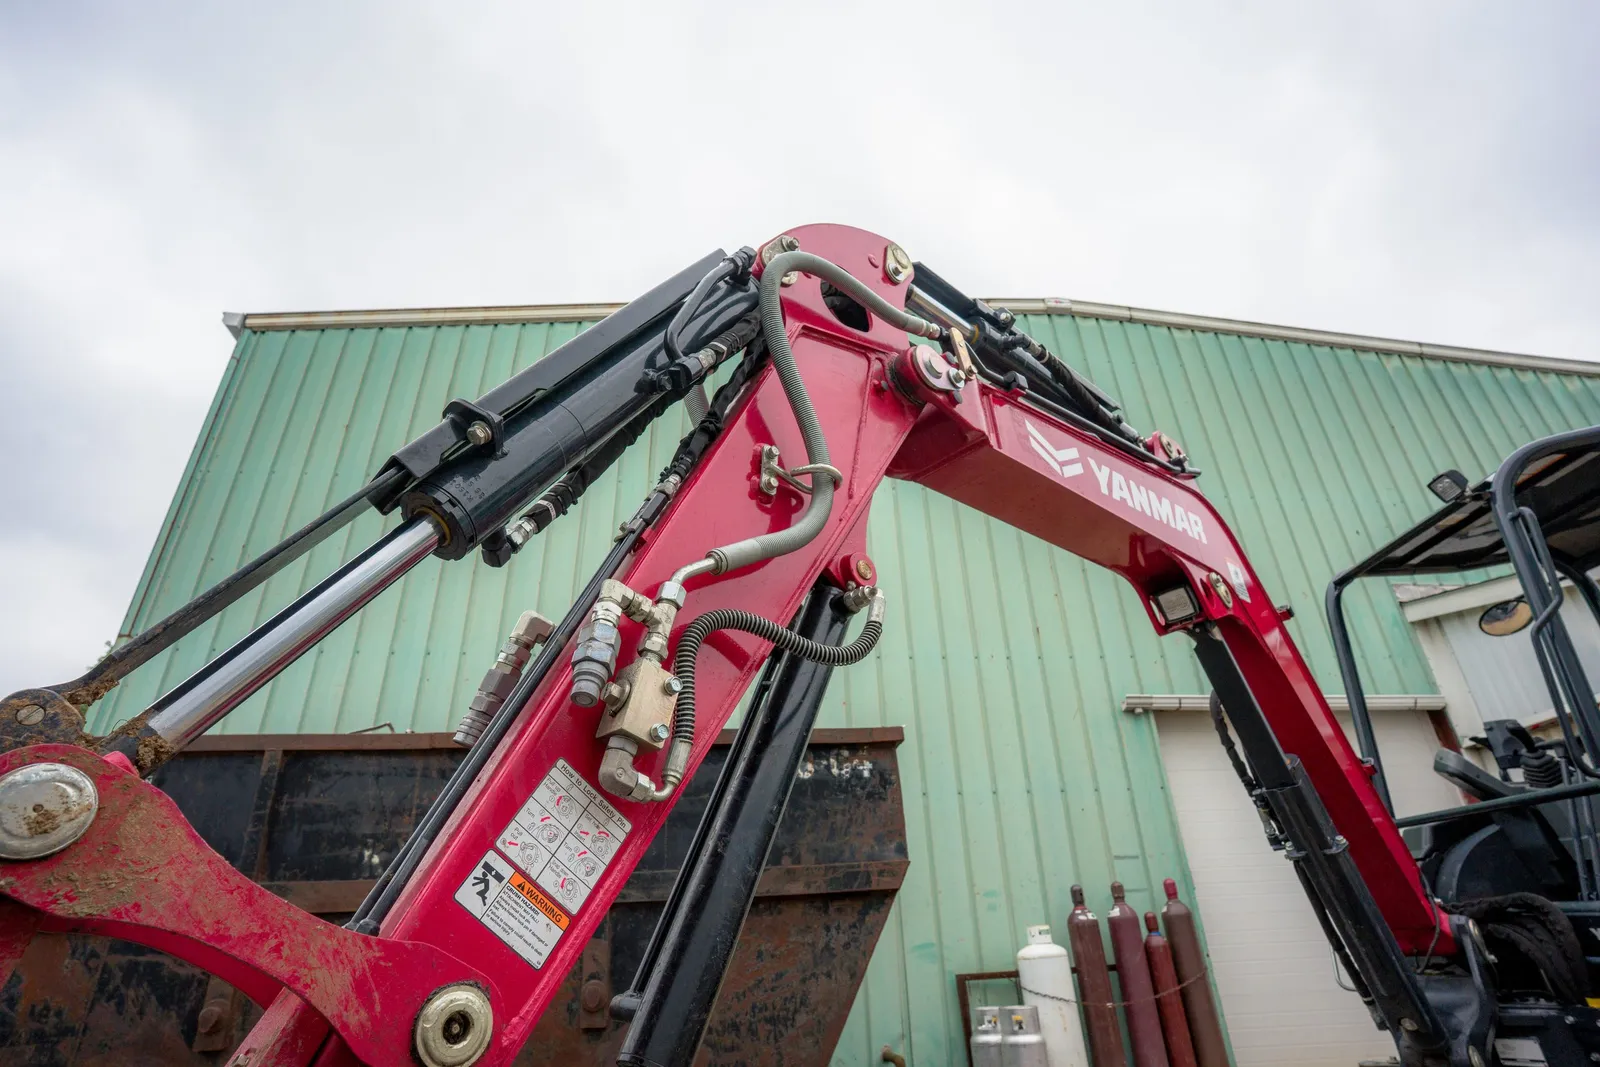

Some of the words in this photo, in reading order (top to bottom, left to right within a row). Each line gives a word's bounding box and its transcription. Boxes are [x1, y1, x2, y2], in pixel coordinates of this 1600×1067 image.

[1087, 456, 1207, 545] YANMAR
[543, 782, 557, 796] Handle
[546, 777, 554, 786] Pull
[560, 764, 575, 778] How
[575, 778, 582, 786] to
[583, 785, 598, 800] Lock
[596, 799, 616, 819] Safety
[616, 816, 626, 828] Pin
[526, 808, 535, 818] Turn
[514, 826, 522, 836] Pull
[563, 842, 572, 852] Turn
[498, 894, 510, 906] Always
[502, 890, 522, 908] ATTACHMENT
[506, 885, 520, 899] CRUSH
[520, 898, 539, 916] HAZARD!
[526, 888, 562, 922] WARNING
[490, 916, 501, 927] serious
[494, 899, 507, 912] Always
[530, 930, 544, 945] damaged
[488, 908, 500, 919] Failure
[502, 921, 514, 932] comply
[514, 930, 522, 939] could
[522, 938, 531, 946] result
[534, 948, 542, 956] death
